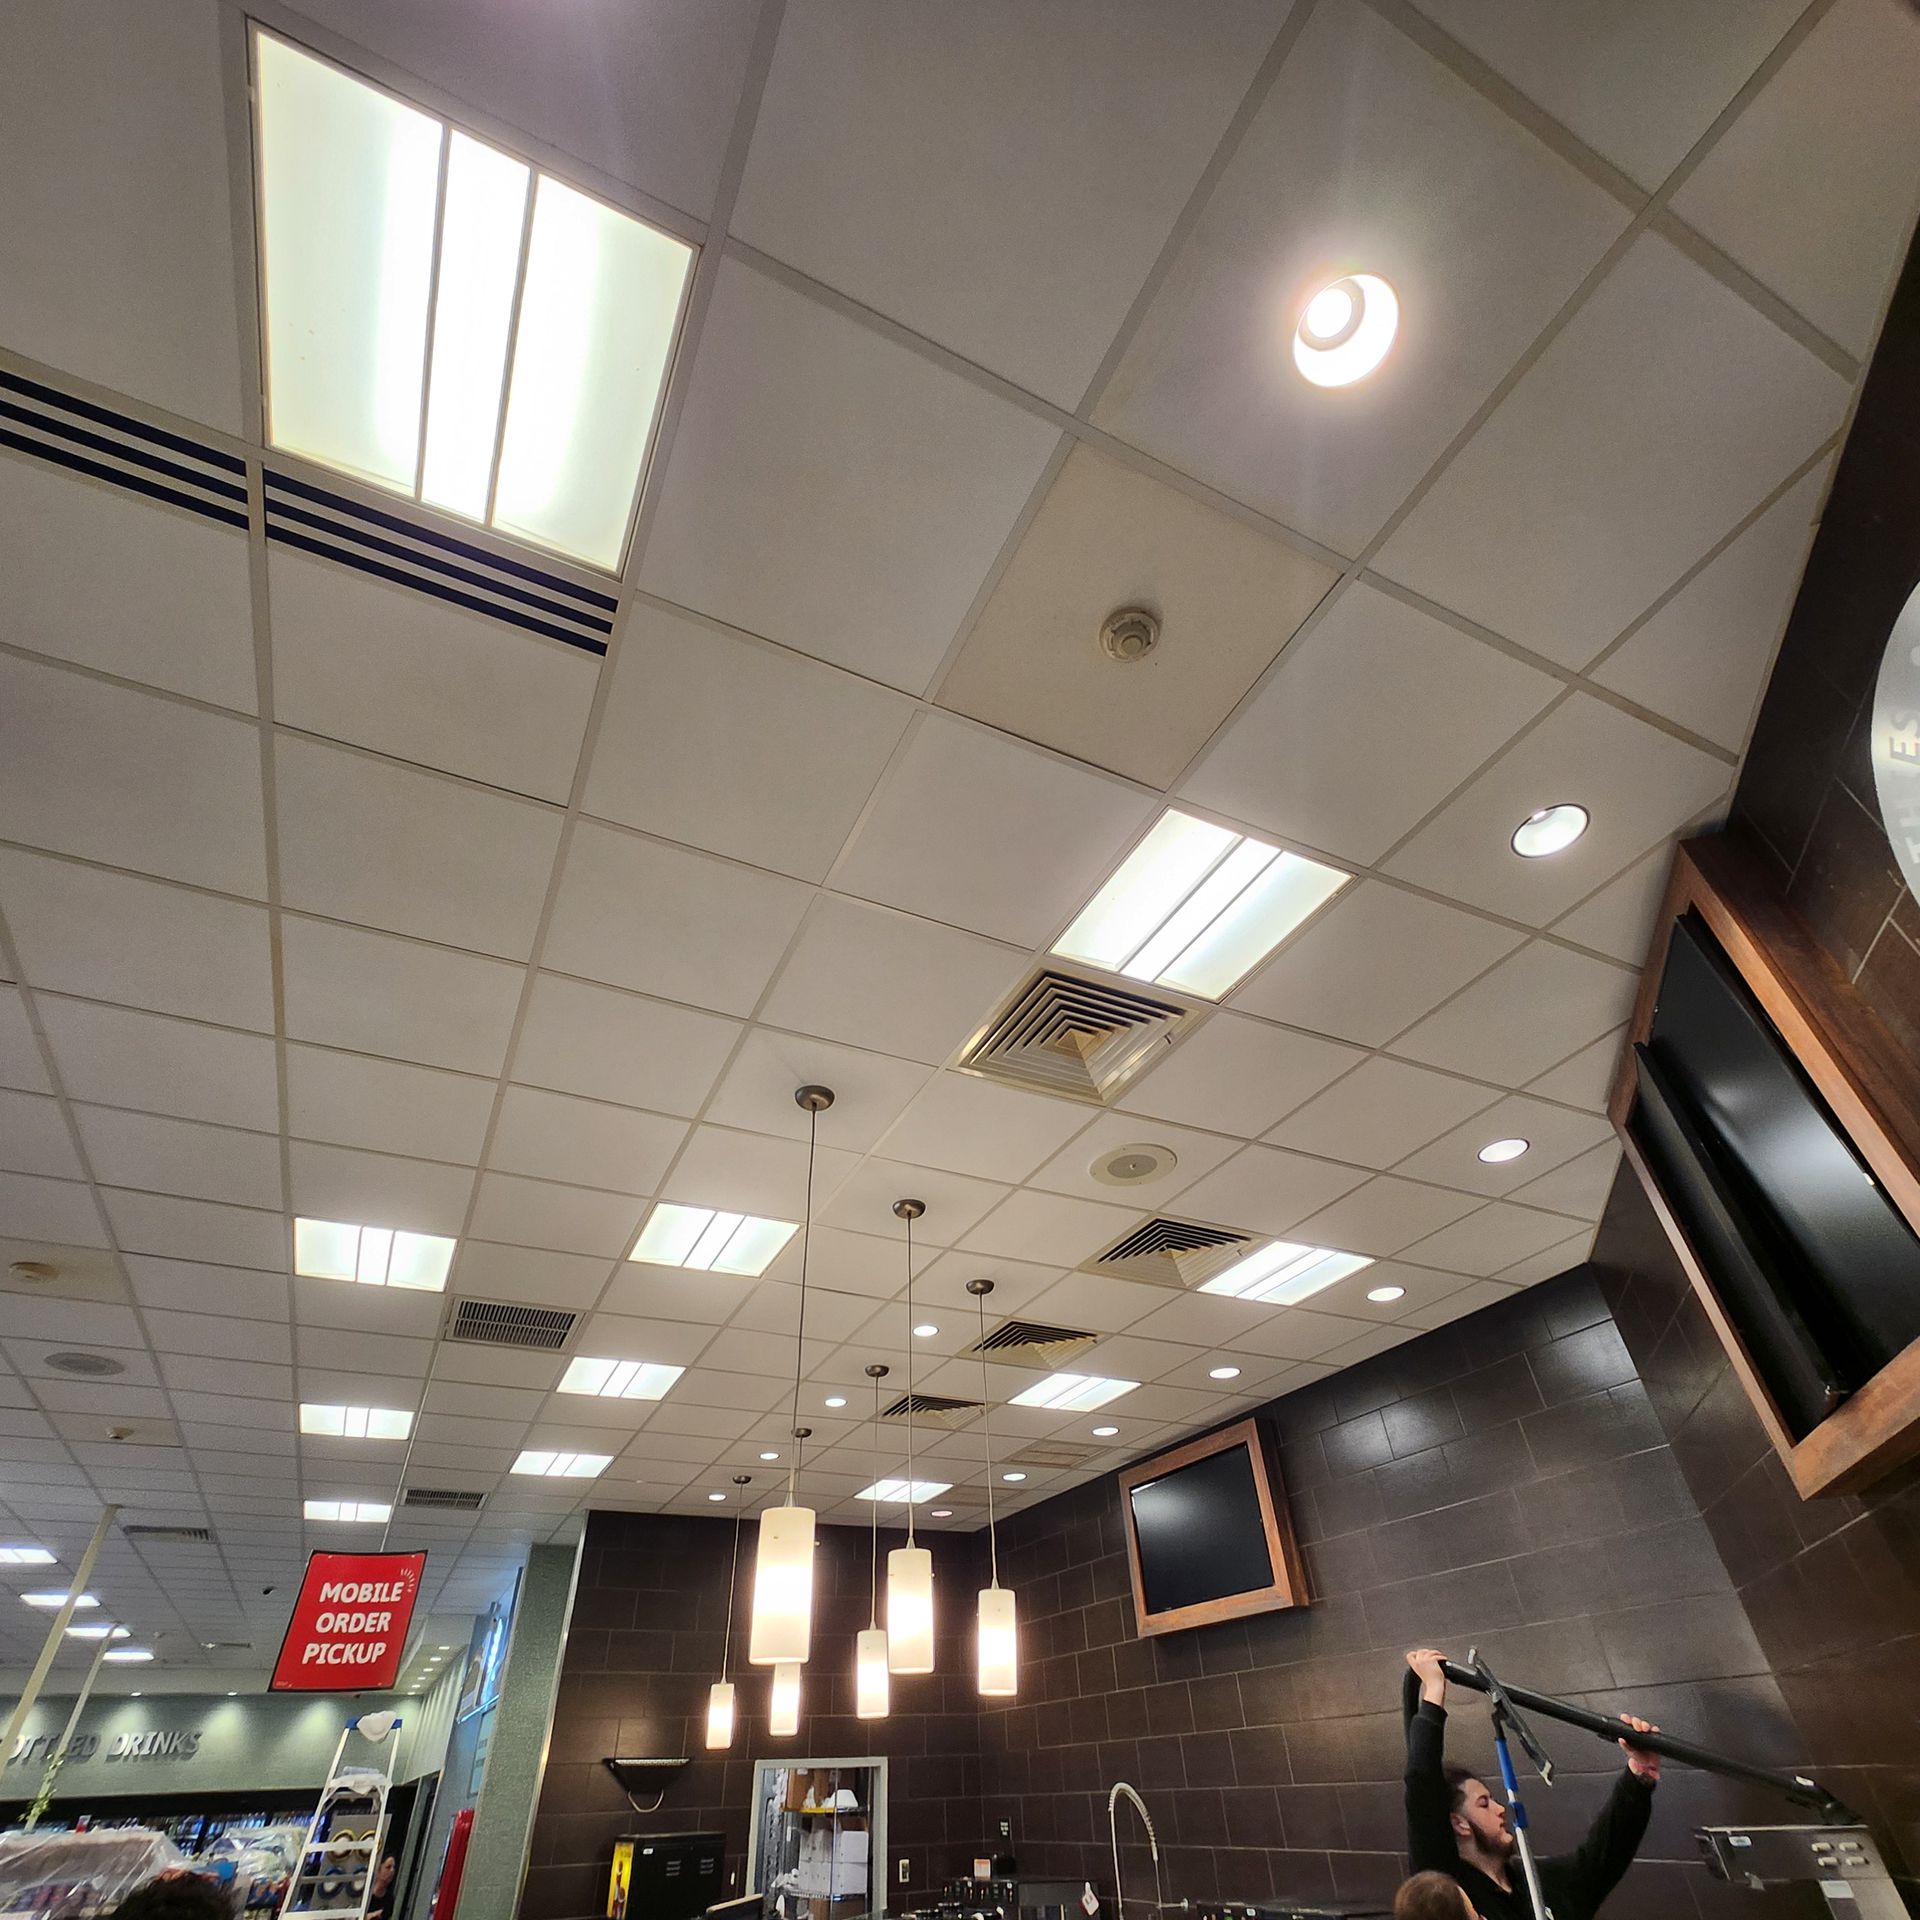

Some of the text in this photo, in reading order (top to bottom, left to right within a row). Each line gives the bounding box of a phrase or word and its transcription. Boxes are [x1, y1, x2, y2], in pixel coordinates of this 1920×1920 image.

[319, 1582, 405, 1603] MOBILE
[315, 1612, 392, 1633] ORDER
[302, 1642, 387, 1665] PICKUP
[1, 1730, 201, 1758] OTTED DRINKS
